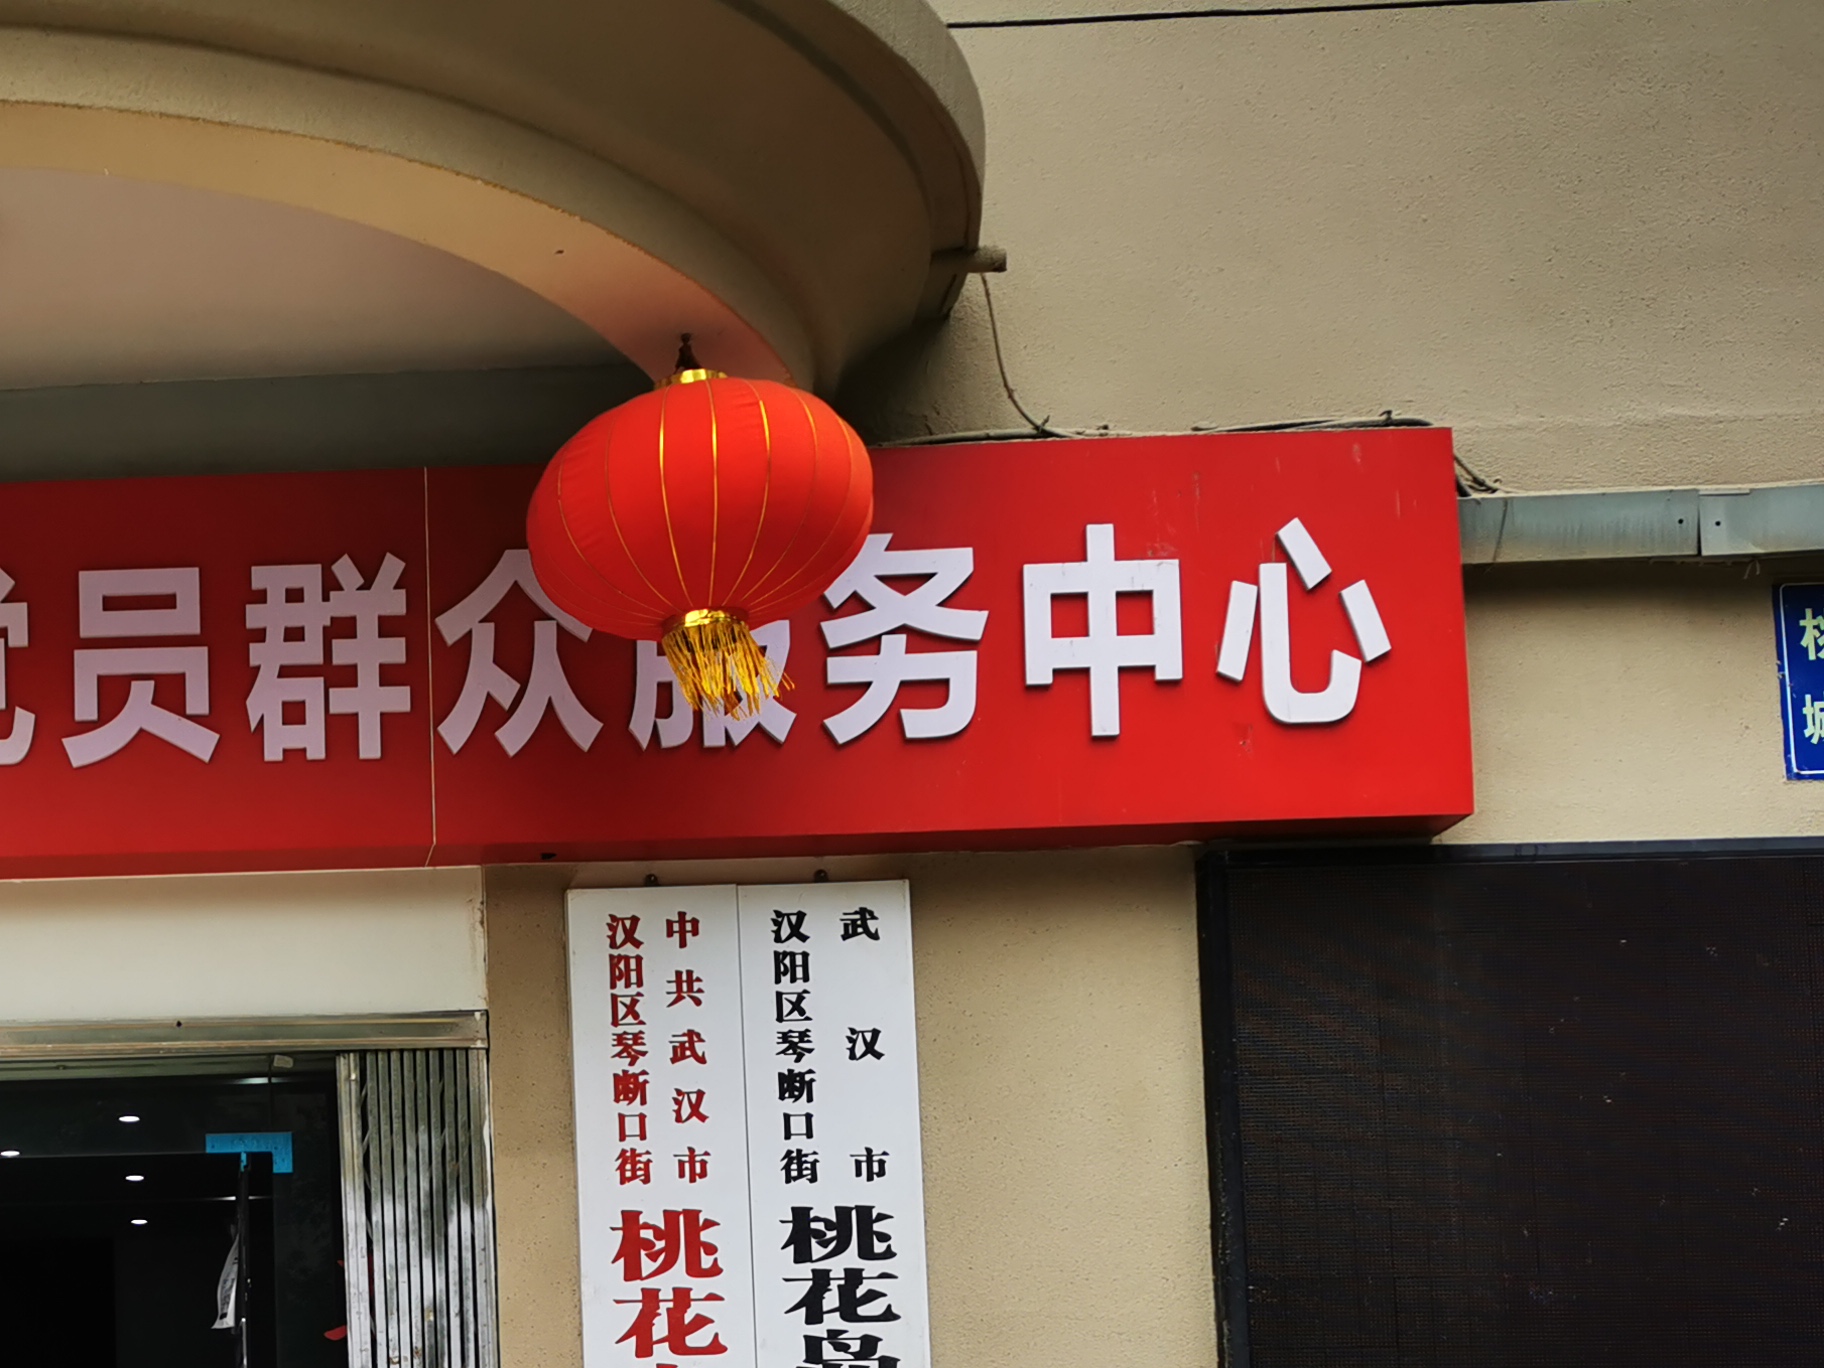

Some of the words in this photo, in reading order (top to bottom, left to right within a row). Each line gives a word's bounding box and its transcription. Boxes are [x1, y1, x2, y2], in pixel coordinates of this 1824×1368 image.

[605, 913, 654, 1186] 汉阳区琴断口街
[664, 910, 711, 1184] 中共武汉市
[771, 908, 820, 1185] 汉阳区琴断口街
[839, 906, 890, 1183] 武汉市
